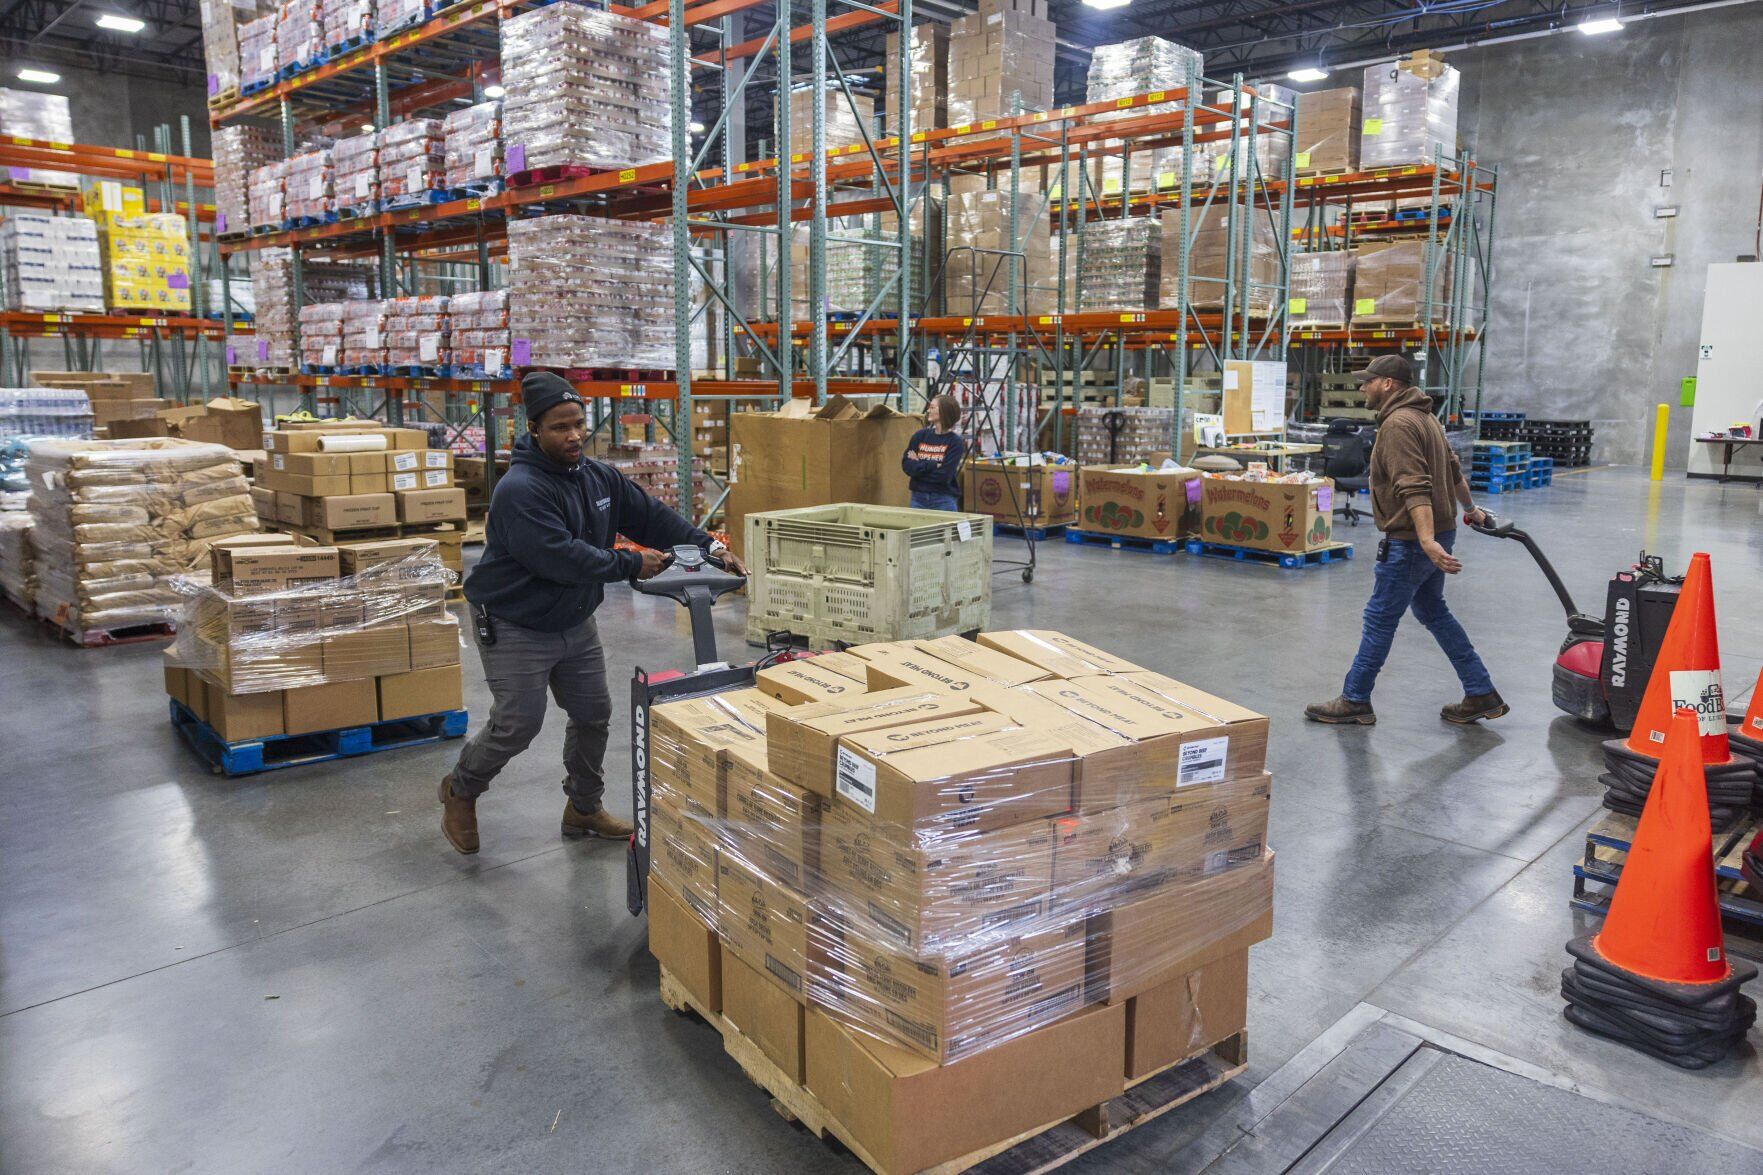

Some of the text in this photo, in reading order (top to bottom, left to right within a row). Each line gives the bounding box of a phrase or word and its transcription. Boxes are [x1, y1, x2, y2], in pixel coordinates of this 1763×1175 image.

[1085, 477, 1145, 500] Watermelons
[1206, 485, 1272, 512] Watermelons
[1611, 597, 1630, 688] RAYMOND
[787, 669, 832, 690] BEYOND MEAT
[899, 661, 954, 684] BEYOND MEAT
[1075, 697, 1138, 725] BEYOND MEAT
[1129, 694, 1166, 712] BEYOND
[843, 707, 920, 725] BEYOND MEAT
[909, 720, 984, 738] BEYOND MEAT
[1182, 749, 1198, 757] BEYOND
[635, 704, 647, 848] RAYMOND
